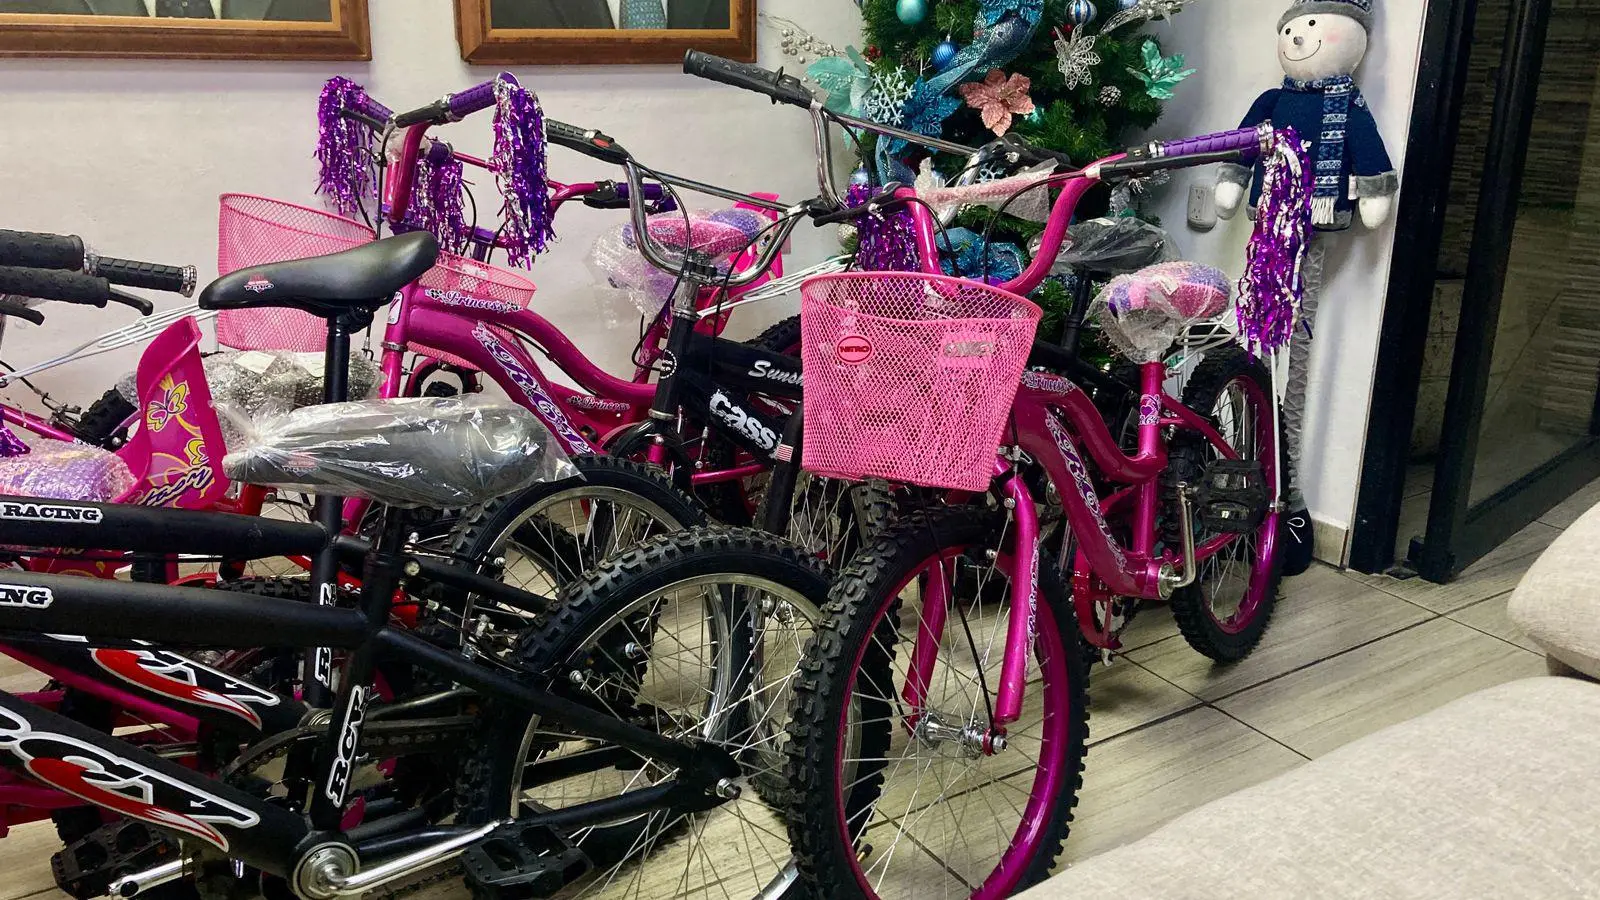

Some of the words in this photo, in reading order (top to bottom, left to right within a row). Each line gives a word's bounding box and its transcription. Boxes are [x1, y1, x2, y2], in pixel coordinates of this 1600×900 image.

[840, 345, 870, 353] NITRO
[3, 503, 100, 521] RACING
[0, 587, 49, 605] NG
